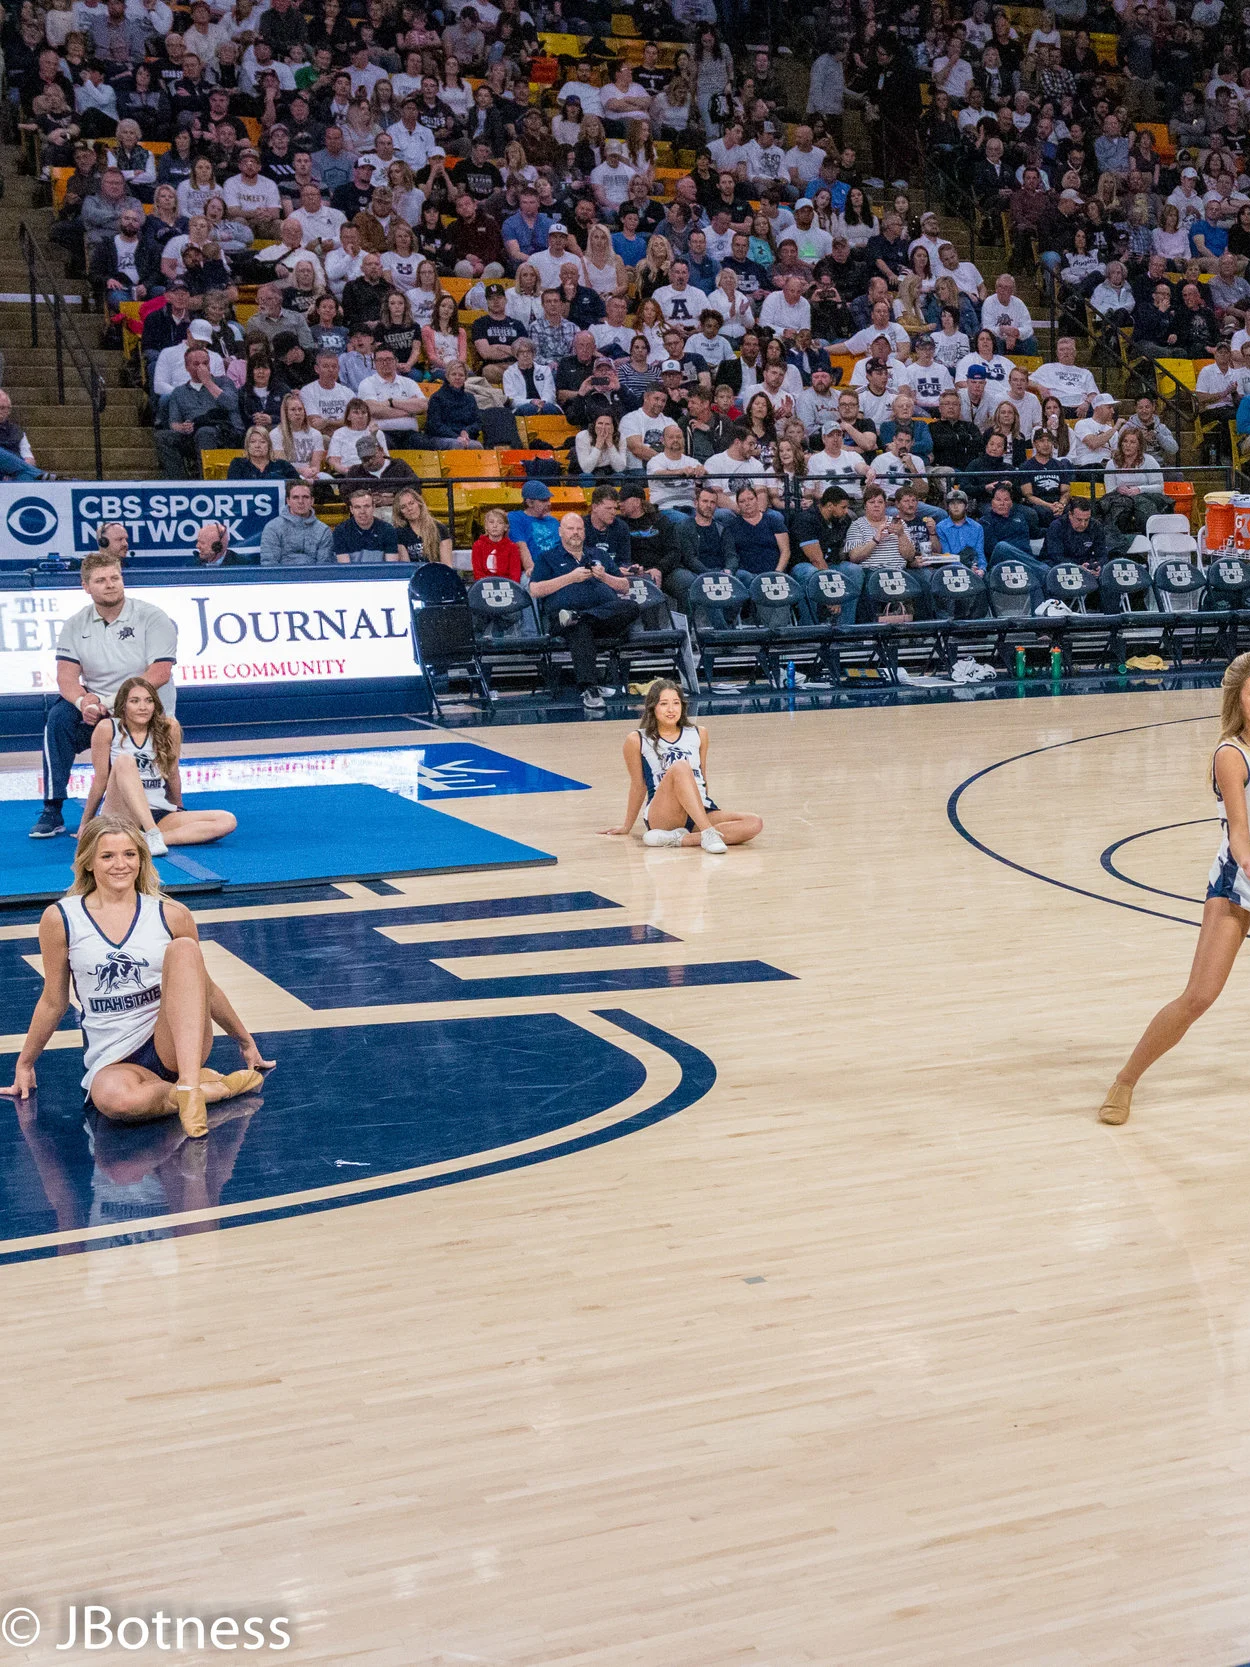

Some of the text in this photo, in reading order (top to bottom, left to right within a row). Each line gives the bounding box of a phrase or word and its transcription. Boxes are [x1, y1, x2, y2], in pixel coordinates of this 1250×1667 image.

[669, 298, 693, 321] A
[78, 493, 273, 520] CBS SPORTS
[81, 519, 245, 545] NTWOK
[15, 597, 59, 614] THE
[178, 658, 347, 682] THE COMMUNITY
[88, 983, 161, 1013] UTAH STATE
